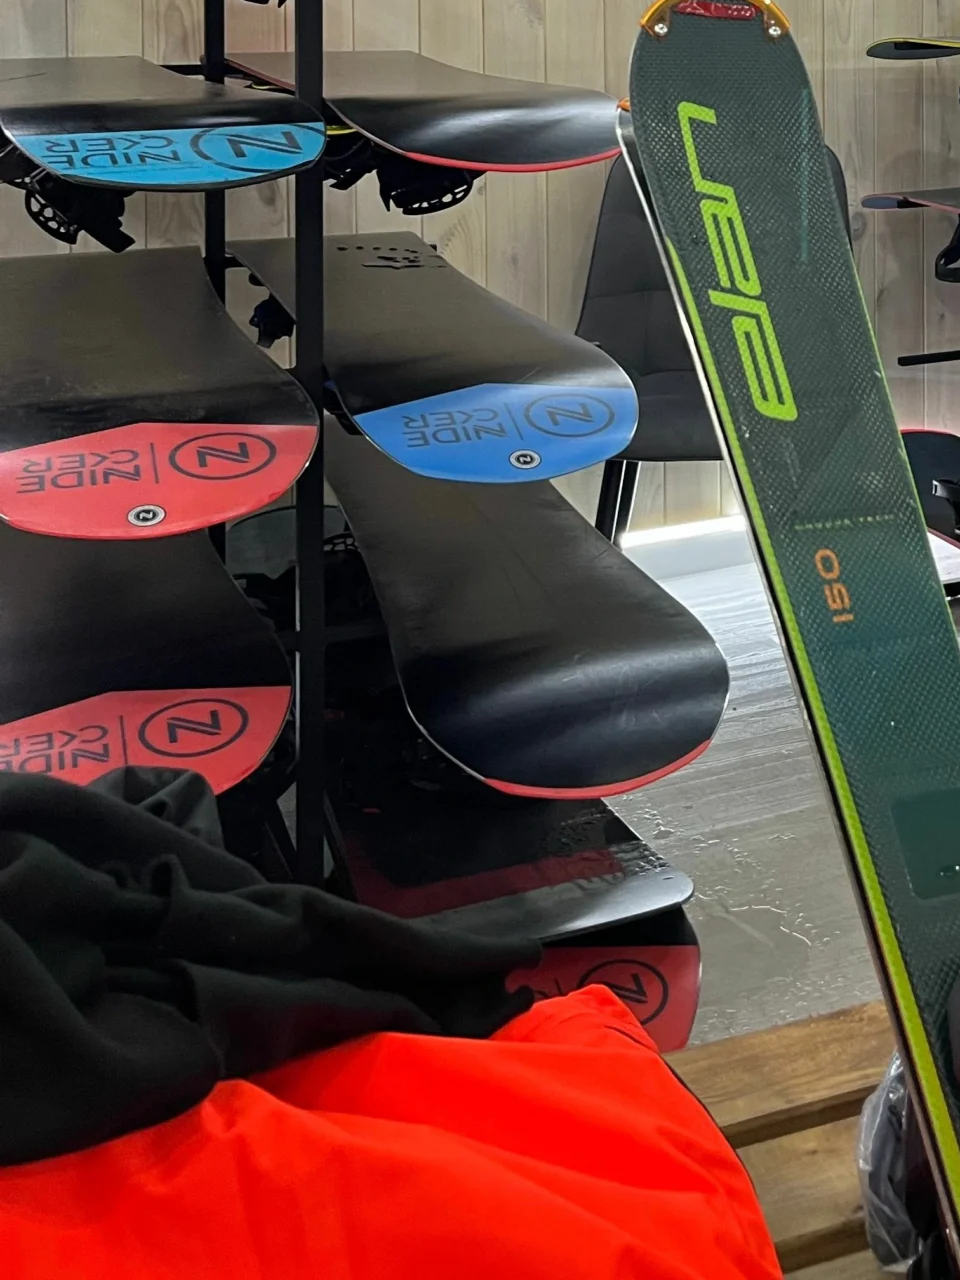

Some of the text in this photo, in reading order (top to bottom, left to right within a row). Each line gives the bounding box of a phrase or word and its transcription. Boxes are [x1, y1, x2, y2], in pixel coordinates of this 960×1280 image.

[406, 422, 508, 448] NIDE
[15, 464, 141, 494] NIDE
[815, 548, 854, 623] 150
[0, 742, 110, 773] NID
